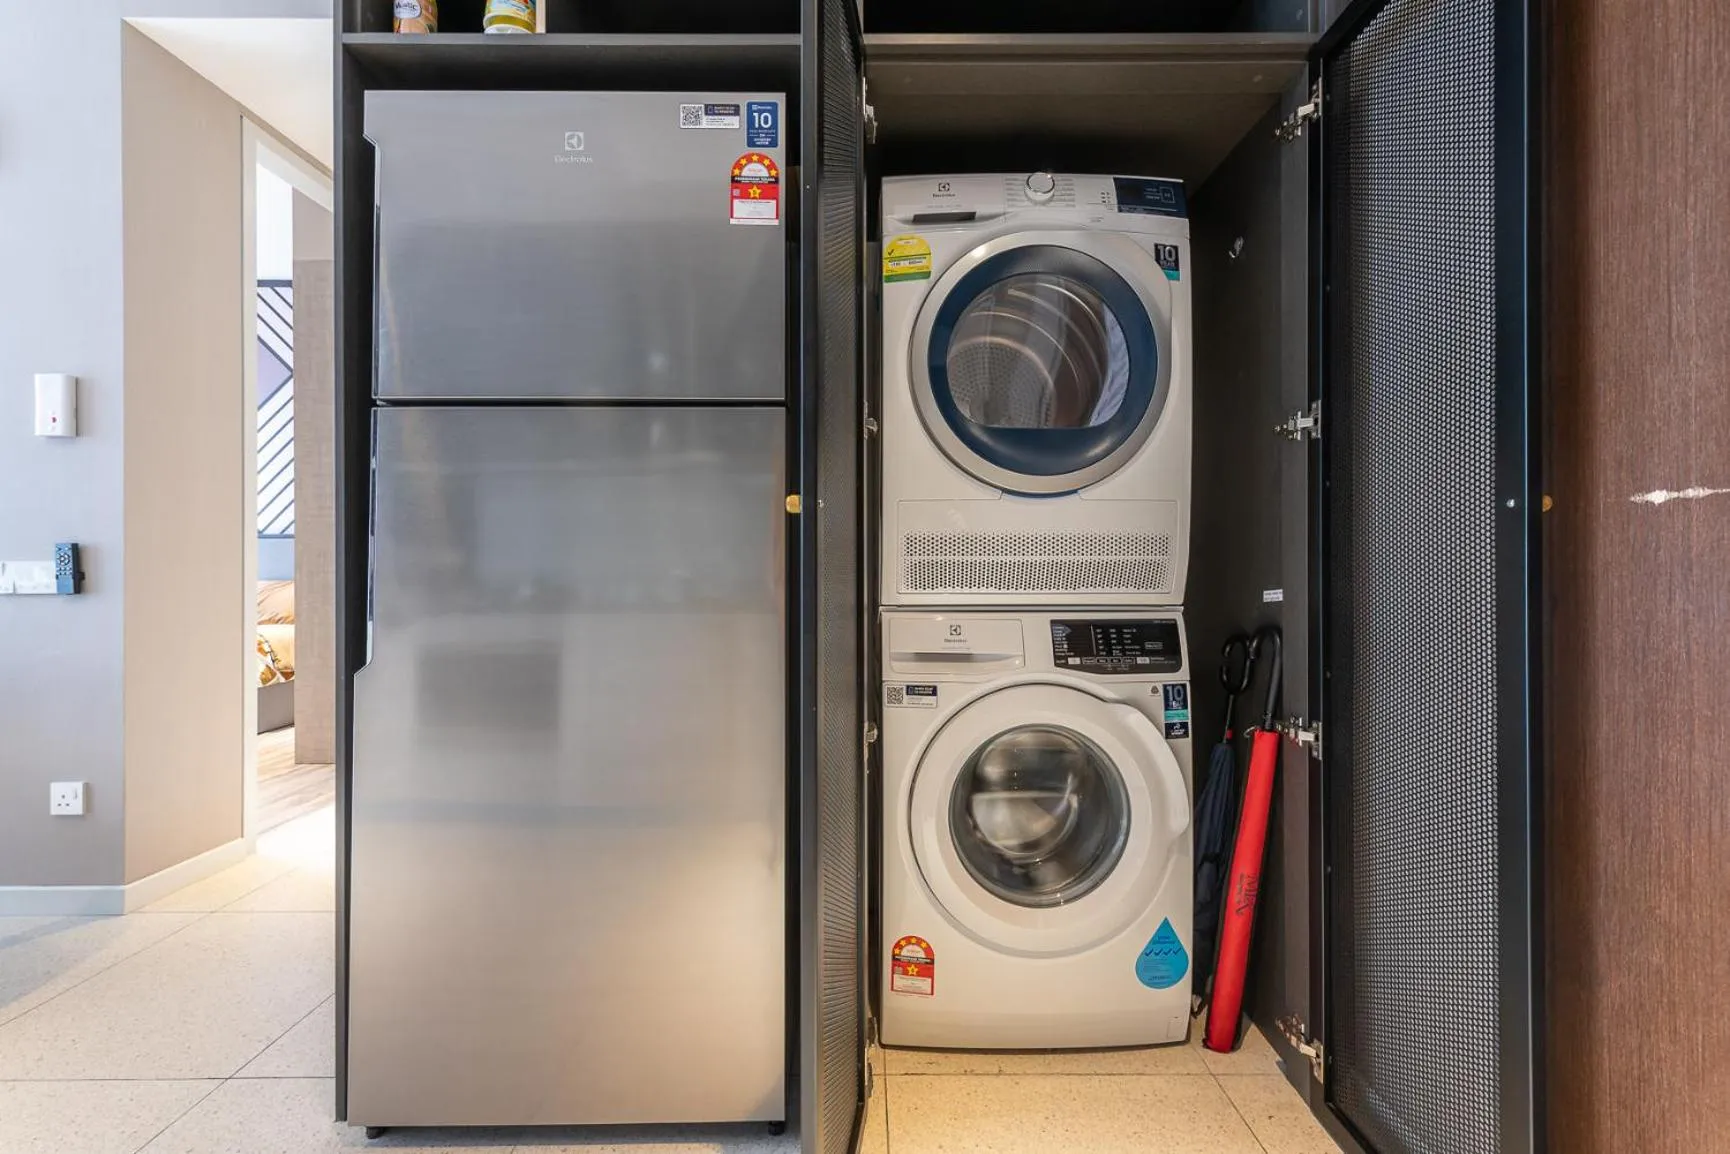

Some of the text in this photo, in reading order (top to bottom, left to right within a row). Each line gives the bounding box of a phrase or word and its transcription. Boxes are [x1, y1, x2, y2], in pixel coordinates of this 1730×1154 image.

[752, 112, 772, 128] 10
[1157, 245, 1176, 262] 10
[1165, 684, 1185, 701] 10
